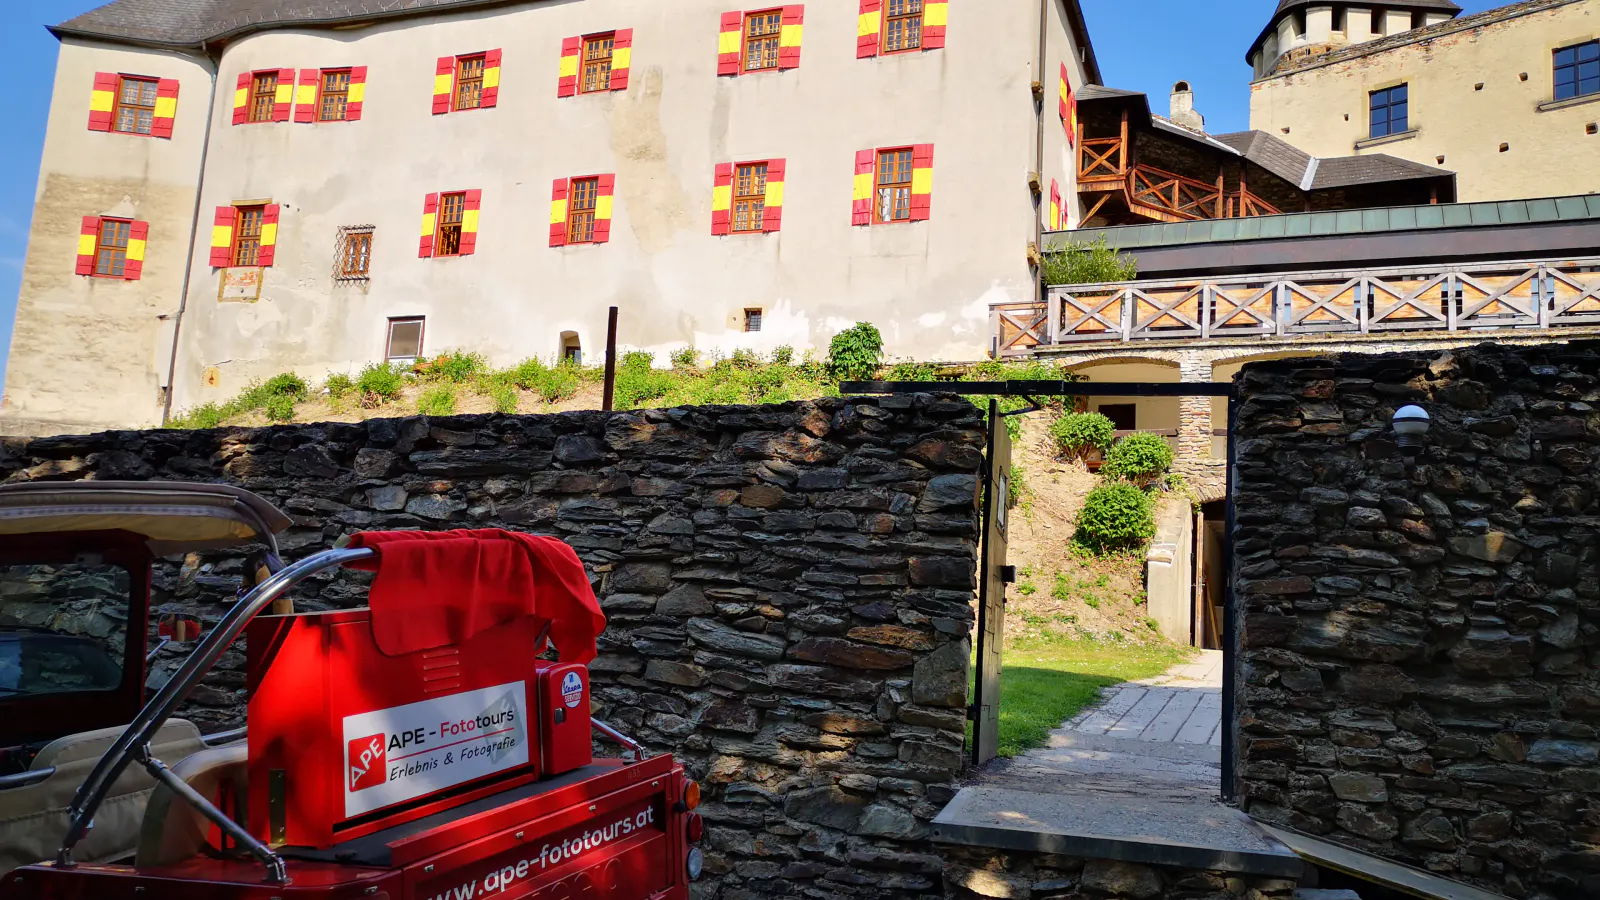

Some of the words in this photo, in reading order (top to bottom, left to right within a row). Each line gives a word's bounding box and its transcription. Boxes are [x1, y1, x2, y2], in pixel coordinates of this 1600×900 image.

[388, 727, 425, 752] APE
[440, 709, 514, 739] Fototours
[351, 738, 384, 788] APE
[390, 757, 438, 781] Erlebnis
[444, 753, 454, 765] &
[460, 736, 516, 762] Fotografie
